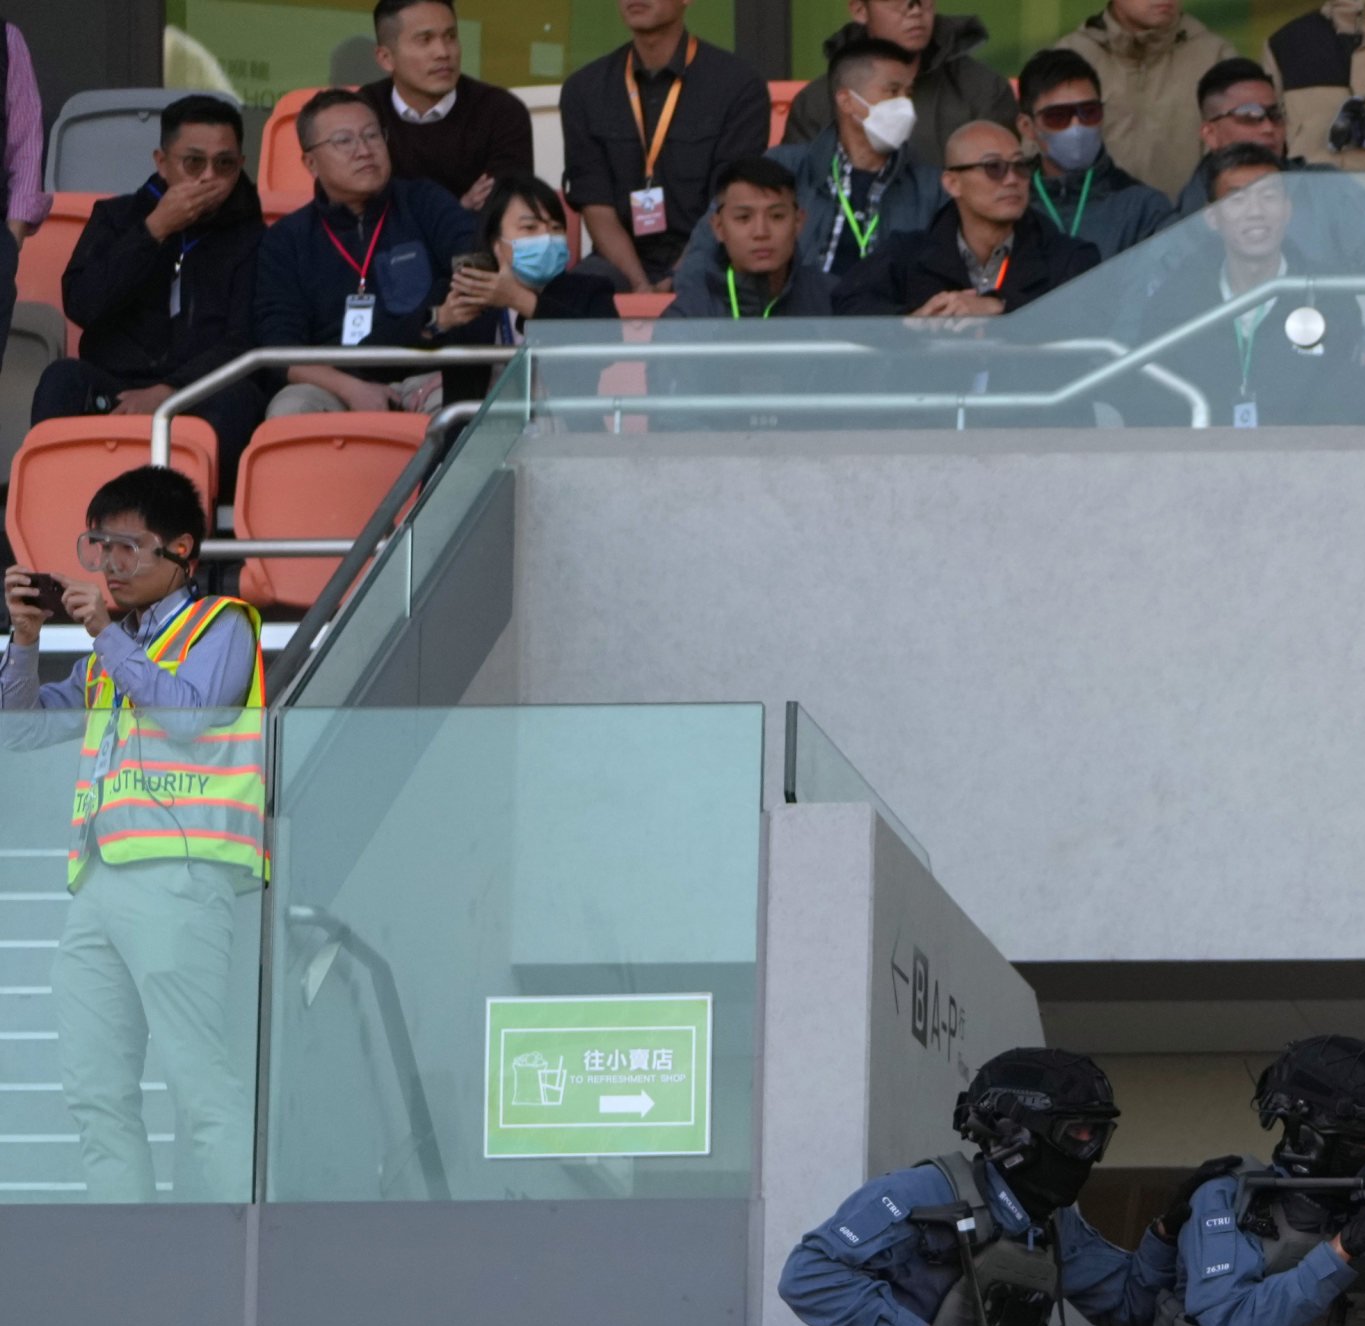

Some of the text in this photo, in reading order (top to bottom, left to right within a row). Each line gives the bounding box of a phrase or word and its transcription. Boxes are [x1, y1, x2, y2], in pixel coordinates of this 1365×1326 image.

[109, 768, 210, 795] UTHORITY
[583, 1048, 674, 1072] 往小賣店
[569, 1073, 687, 1085] TO REFRESHMENT SHOP
[881, 1196, 903, 1218] CTRU
[1205, 1216, 1231, 1228] CTRU
